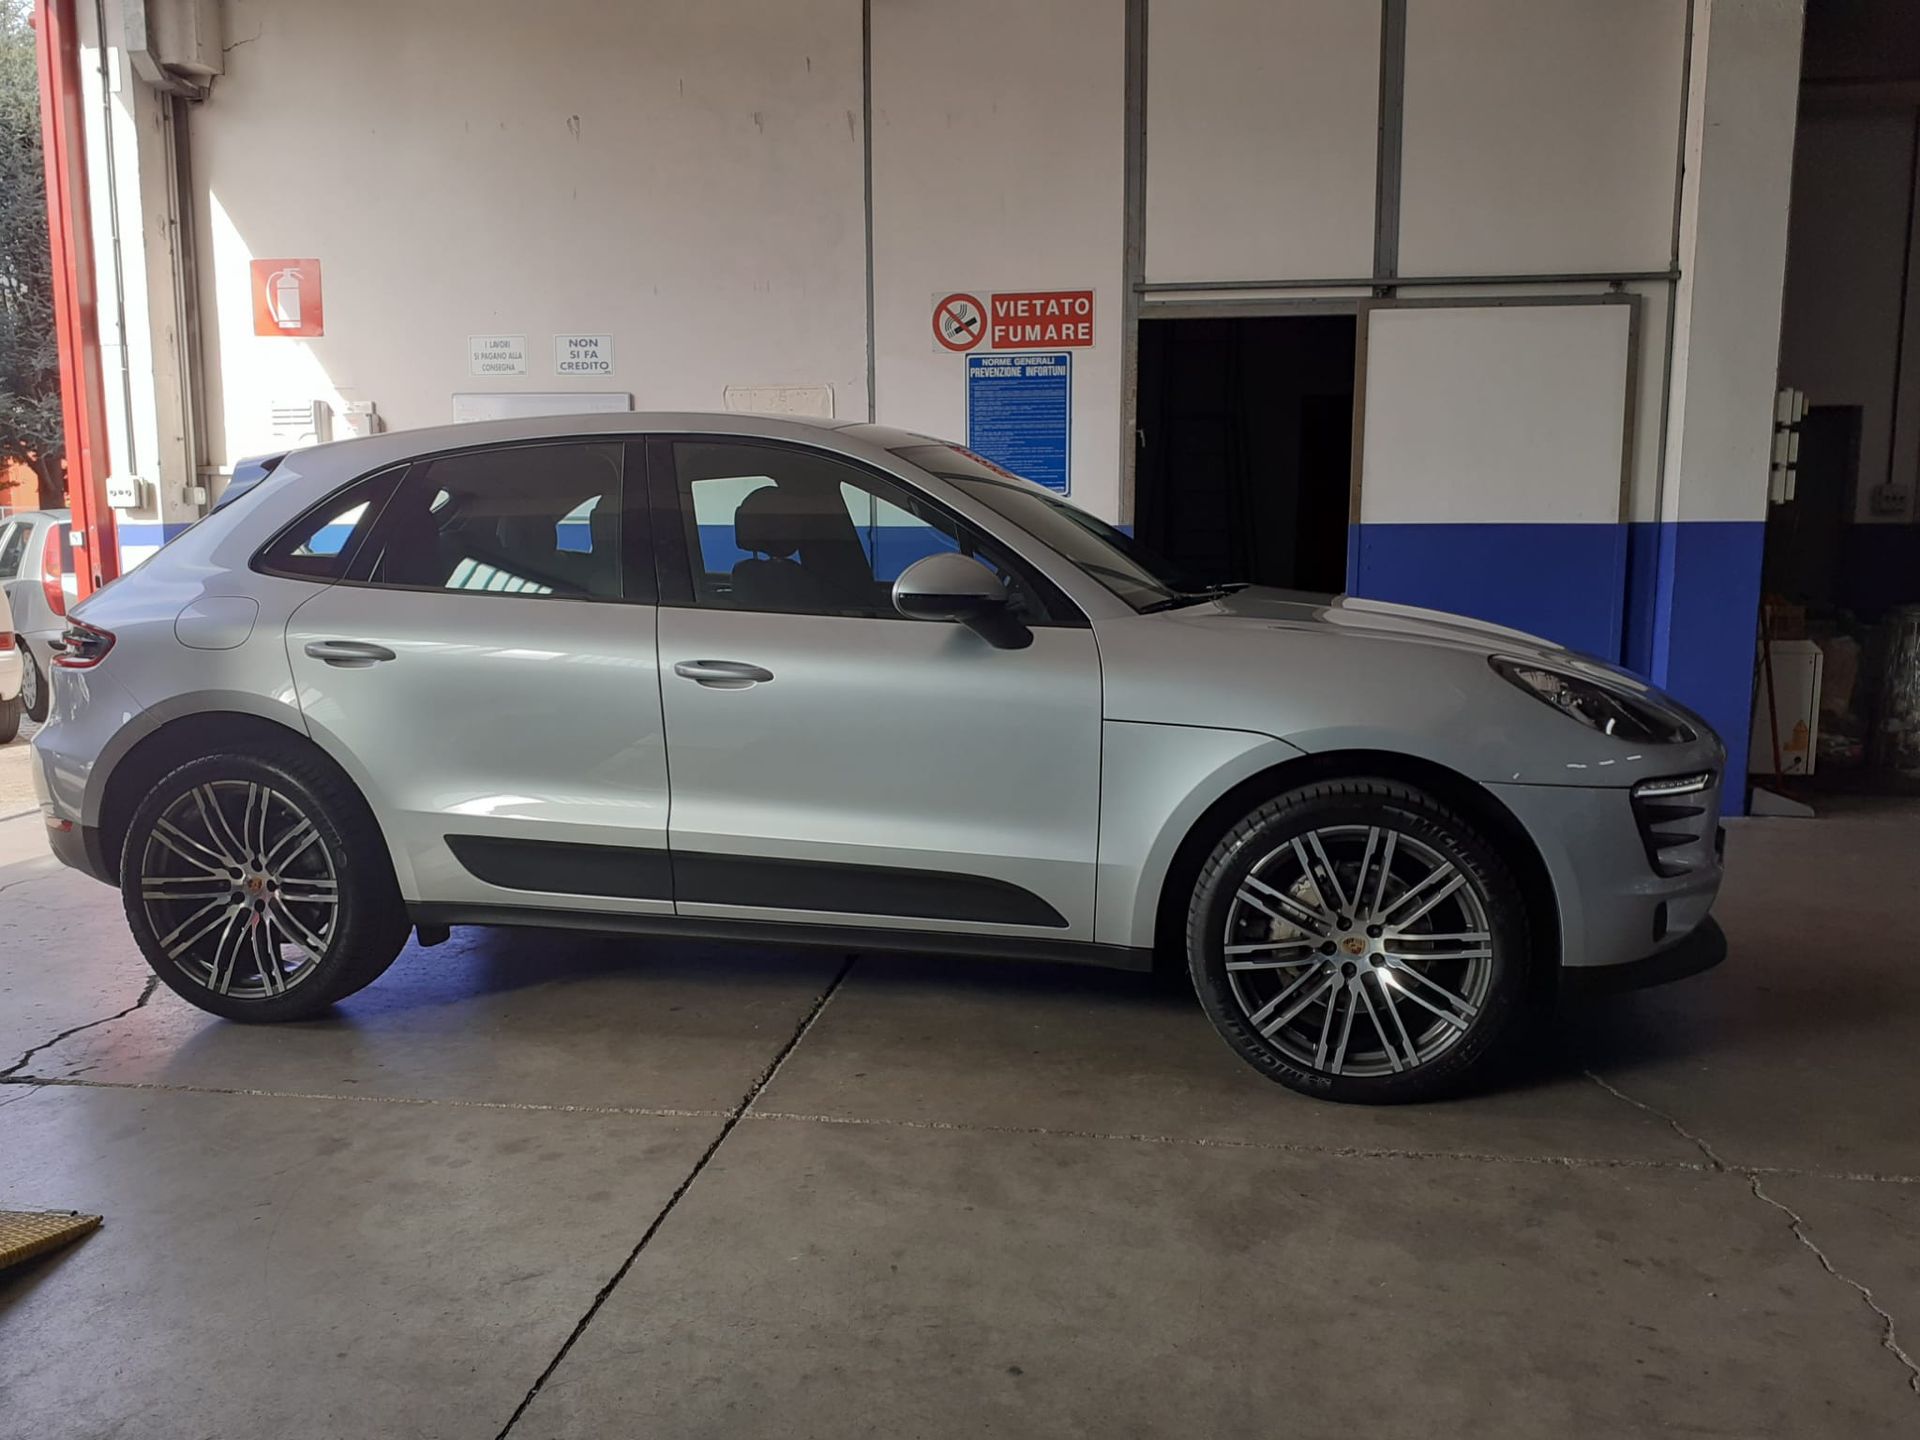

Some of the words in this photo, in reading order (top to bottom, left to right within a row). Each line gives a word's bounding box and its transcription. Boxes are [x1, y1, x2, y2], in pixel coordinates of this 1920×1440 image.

[995, 297, 1090, 317] VIETATO
[994, 322, 1090, 342] FUMARE
[489, 340, 511, 349] LAVORI
[568, 338, 598, 348] NON
[508, 351, 523, 360] ALLA
[570, 350, 580, 359] SI
[584, 350, 599, 359] FA
[560, 361, 609, 371] CREDITO
[982, 358, 1013, 367] NORME
[1014, 356, 1056, 365] GENERALI
[481, 363, 516, 372] CONSEGNA
[970, 366, 1022, 378] PREVENZIONE
[1025, 365, 1066, 377] INFORTUNI
